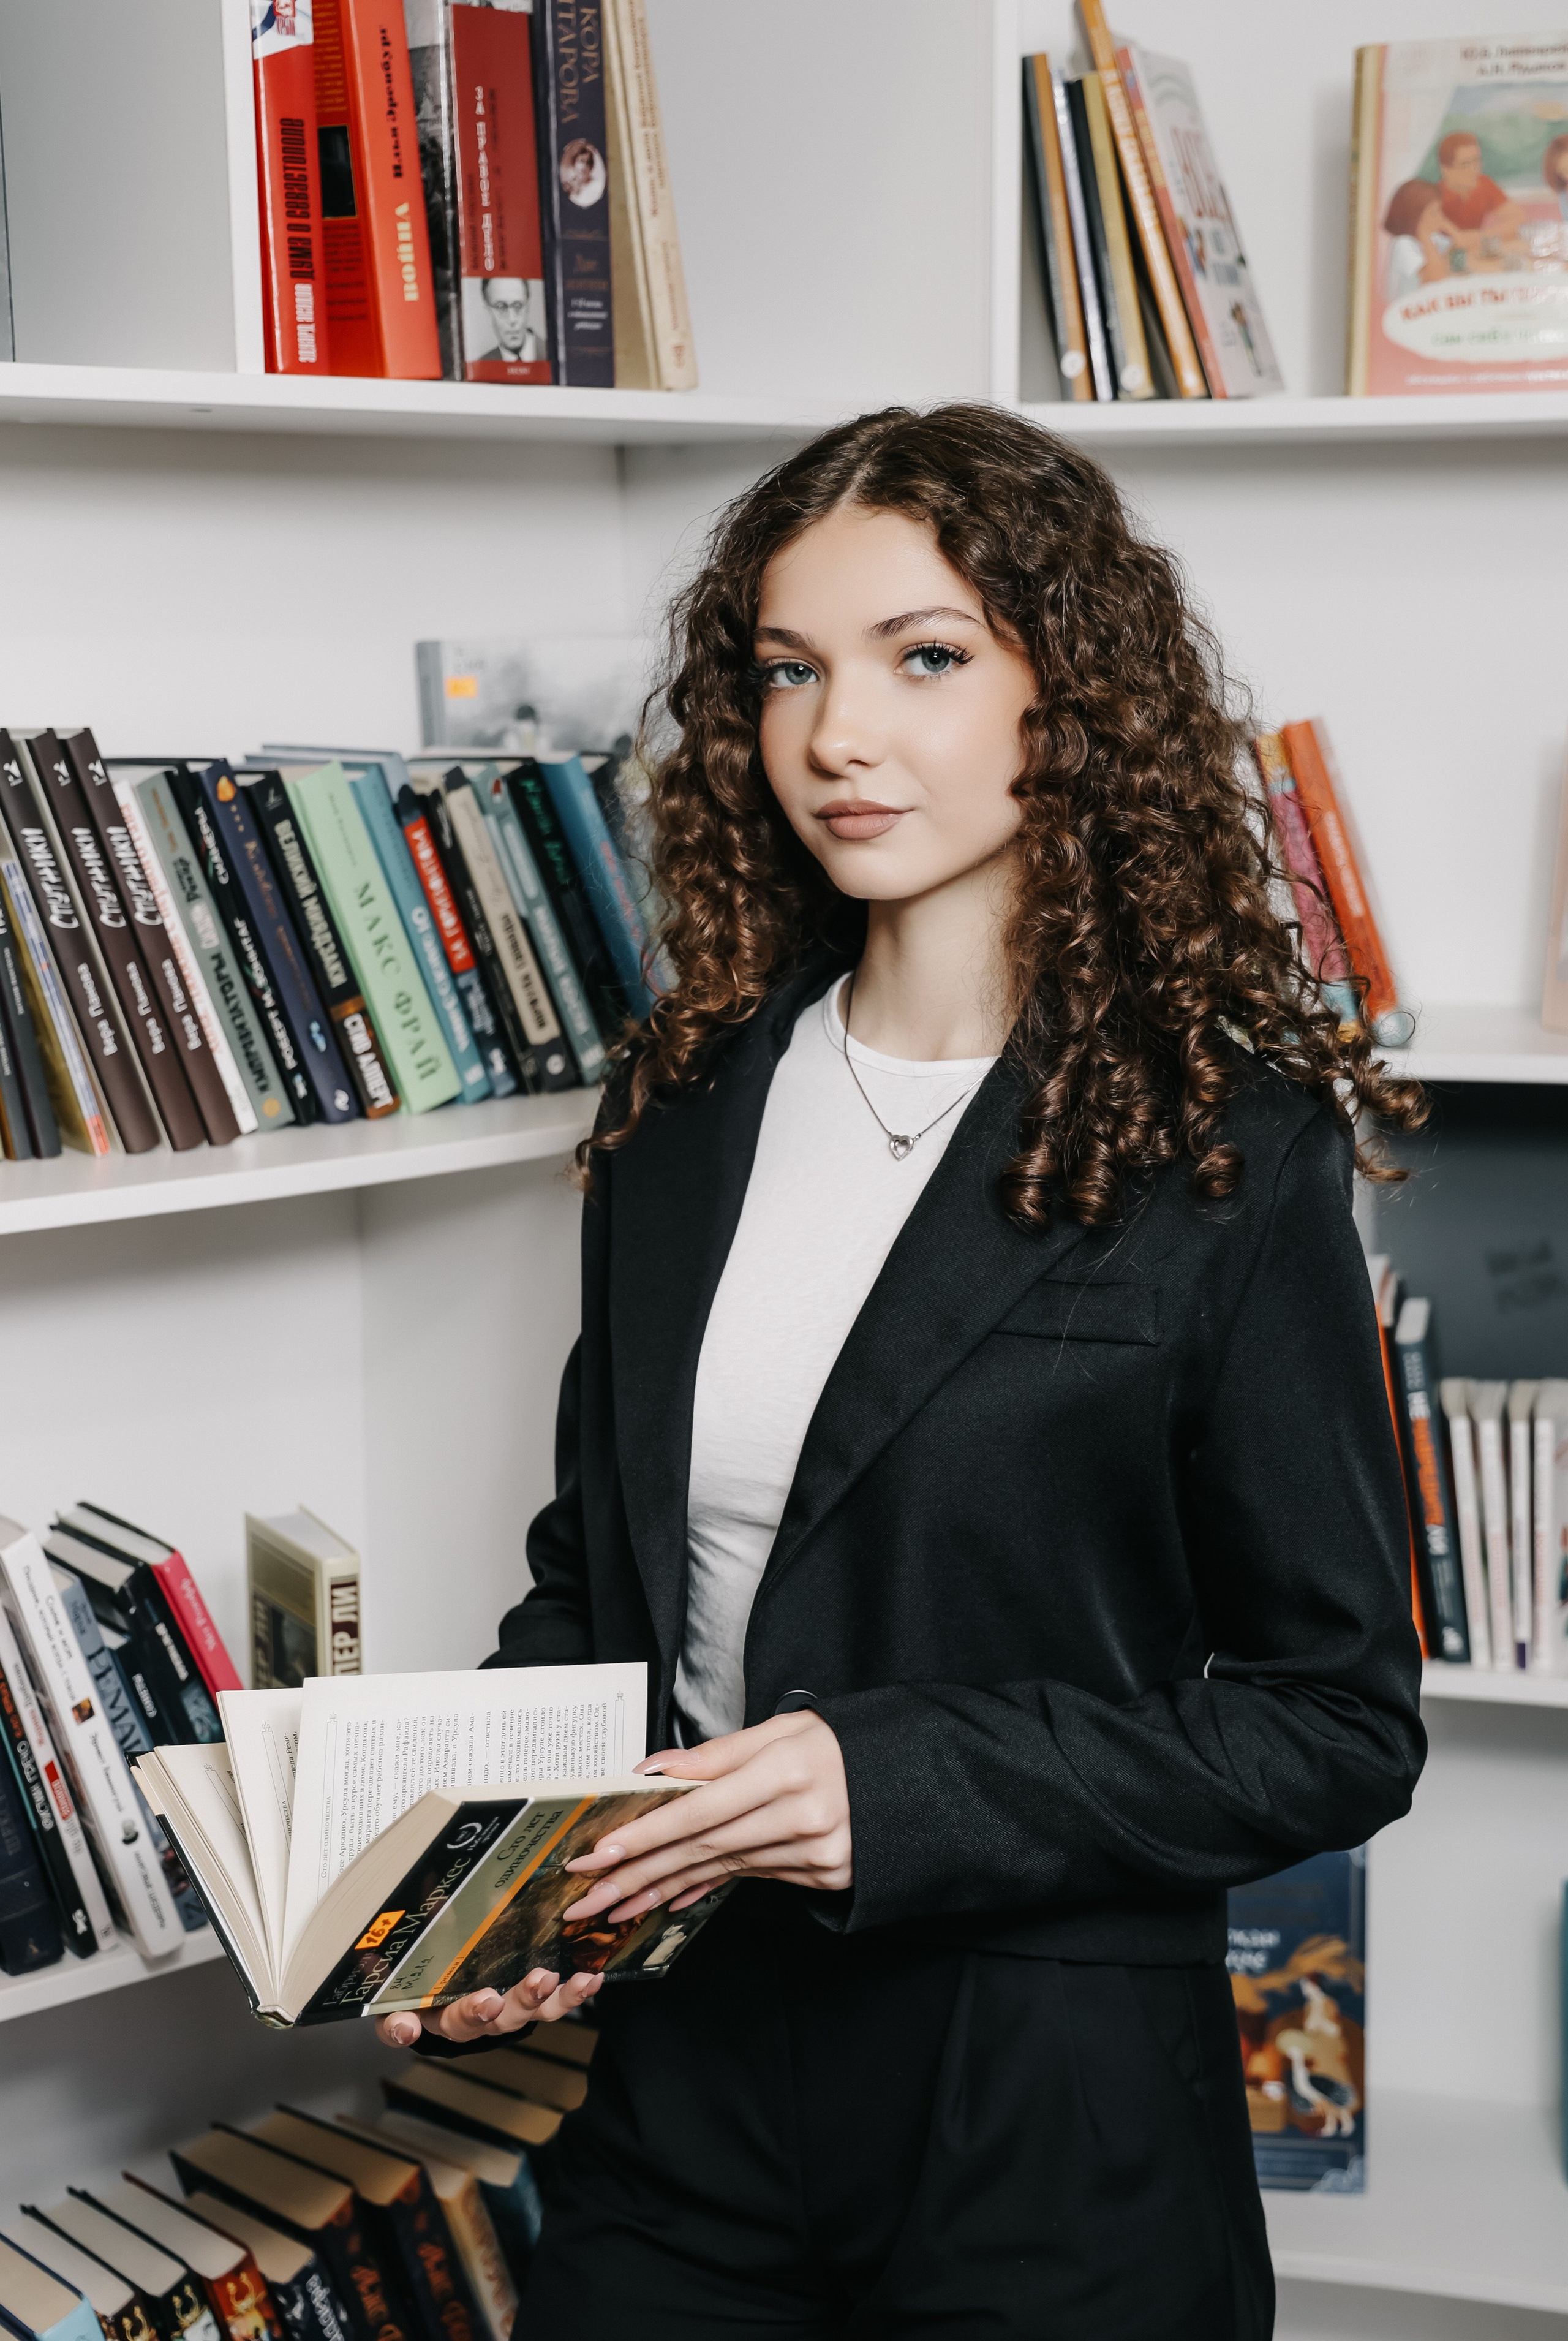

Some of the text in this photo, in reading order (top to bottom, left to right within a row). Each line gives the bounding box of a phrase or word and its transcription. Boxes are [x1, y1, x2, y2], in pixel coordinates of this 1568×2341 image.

[578, 7, 605, 83] КОРА
[475, 121, 491, 206] ПРАВОЕ
[280, 118, 314, 279] ДУМА О СЕВАСТОПОЛЕ
[395, 203, 418, 301] ВОЙНА
[21, 826, 78, 929] Спутники
[72, 828, 125, 927] Спутники
[107, 826, 162, 929] Спутники
[274, 820, 316, 898] ВЕЛИКИЙ
[358, 882, 401, 973] МАКС
[394, 991, 440, 1079] ФРАЙ
[77, 963, 117, 1056] Вера Панова
[126, 962, 165, 1054] Вера Панова
[162, 959, 201, 1050] Вера Панова
[331, 1584, 358, 1622] ЛИ
[377, 1720, 385, 1746] разли-
[451, 1714, 460, 1741] Урсула
[501, 1710, 507, 1719] ей
[570, 1705, 579, 1737] фигурку
[600, 1703, 609, 1738] глубокой
[282, 1731, 292, 1754] Реме-
[360, 1739, 369, 1762] Когда
[425, 1715, 435, 1774] определять на
[433, 1715, 443, 1774] Иногда случа-
[442, 1730, 451, 1769] Амаранта
[513, 1708, 523, 1773] то поднималось
[521, 1733, 530, 1764] галерее,
[529, 1708, 539, 1766] передвигались
[537, 1737, 546, 1764] Урсуле
[554, 1731, 562, 1749] руки
[359, 1764, 368, 1787] доме.
[375, 1749, 384, 1782] ребенка
[399, 1717, 411, 1798] архангела Рафаила?
[409, 1768, 415, 1777] ей
[417, 1766, 424, 1775] до
[560, 1745, 569, 1776] каждым
[341, 1788, 349, 1816] Урсула
[350, 1780, 358, 1802] курсе
[366, 1758, 375, 1808] переодевает
[374, 1785, 382, 1816] обучает
[339, 1818, 348, 1857] Аркадио.
[495, 1810, 564, 1888] одиночества
[497, 1812, 545, 1860] Сто лет
[339, 1857, 471, 2005] Гарсиа Маркес
[366, 1918, 391, 1944] 16+
